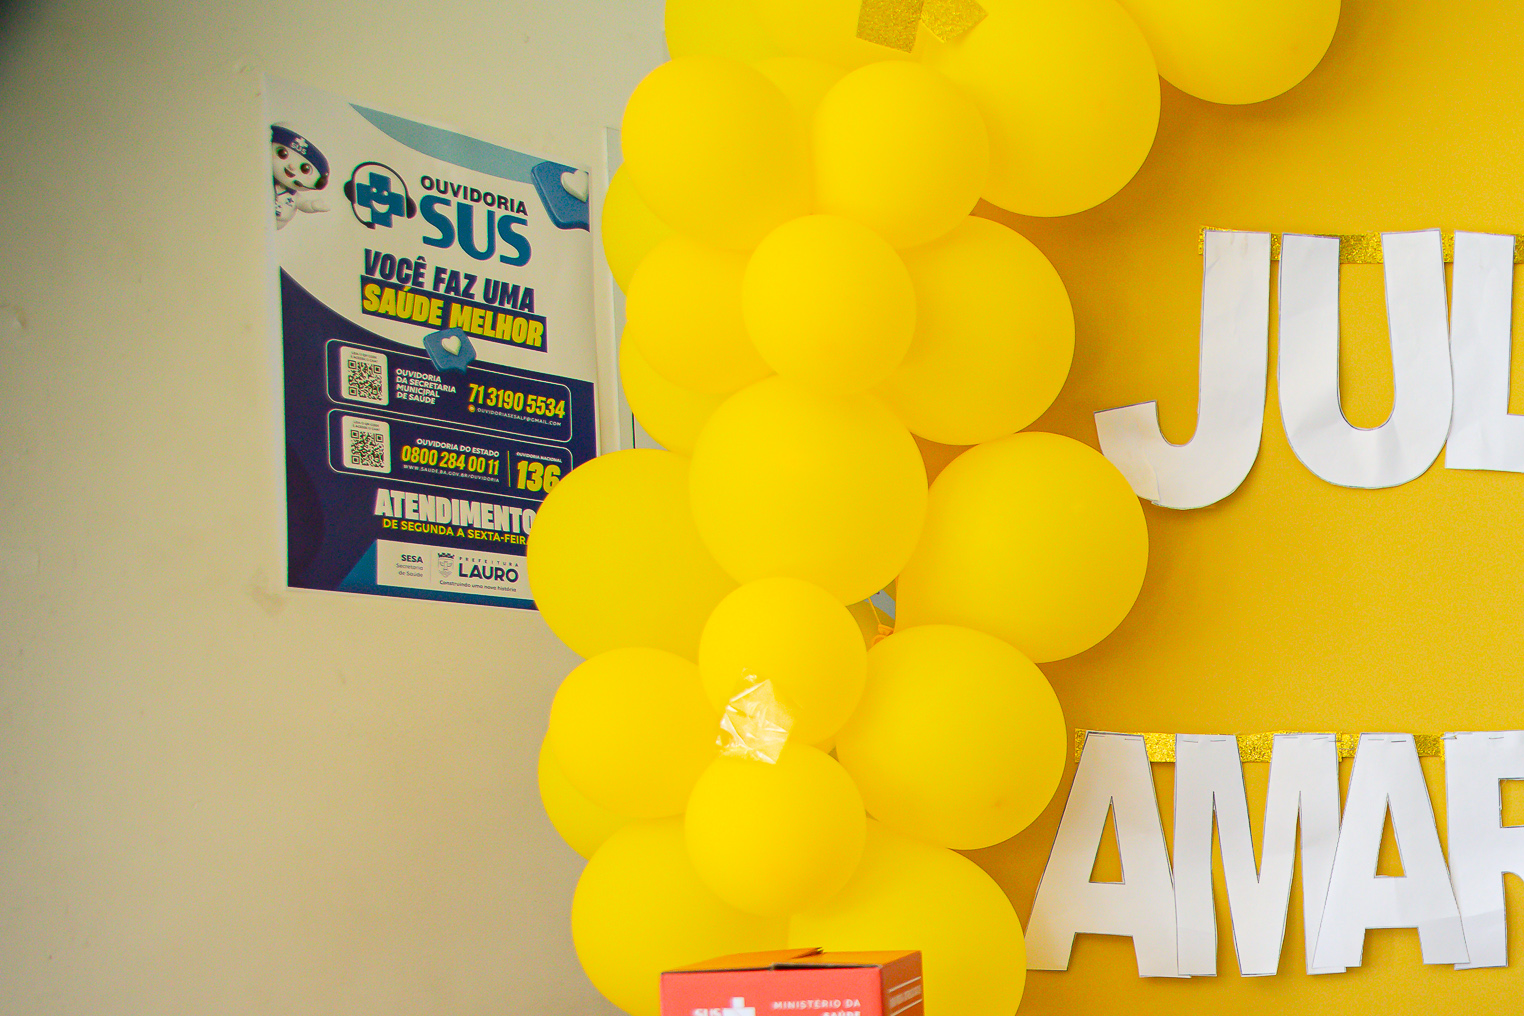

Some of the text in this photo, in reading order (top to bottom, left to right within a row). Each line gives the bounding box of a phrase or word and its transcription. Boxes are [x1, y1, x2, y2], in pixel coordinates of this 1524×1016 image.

[420, 175, 528, 216] OUVIDORIA
[419, 194, 532, 267] SUS
[364, 248, 535, 313] VOCÊ FAZ UMA
[363, 281, 544, 348] SAÚDE MELHOR
[395, 368, 442, 382] OUVIDORIA
[396, 376, 457, 394] DA SECRETARIA
[396, 384, 440, 398] MUNICIPAL
[396, 391, 408, 400] DE
[468, 383, 565, 419] 71 3190 5534
[416, 438, 500, 458] OUVIDORIA DO ESTADO
[401, 445, 500, 476] 0800 284 00 11
[517, 460, 561, 494] 136
[374, 488, 537, 535] ATENDIMENTO
[382, 518, 527, 546] DE SEGUNDA A SEXTA-FEIR
[396, 563, 424, 571] Secretaria
[401, 554, 424, 564] SESA
[459, 556, 519, 567] PREFEITURA
[458, 563, 519, 583] LAURO
[772, 998, 861, 1010] MINISTÉRIO DA
